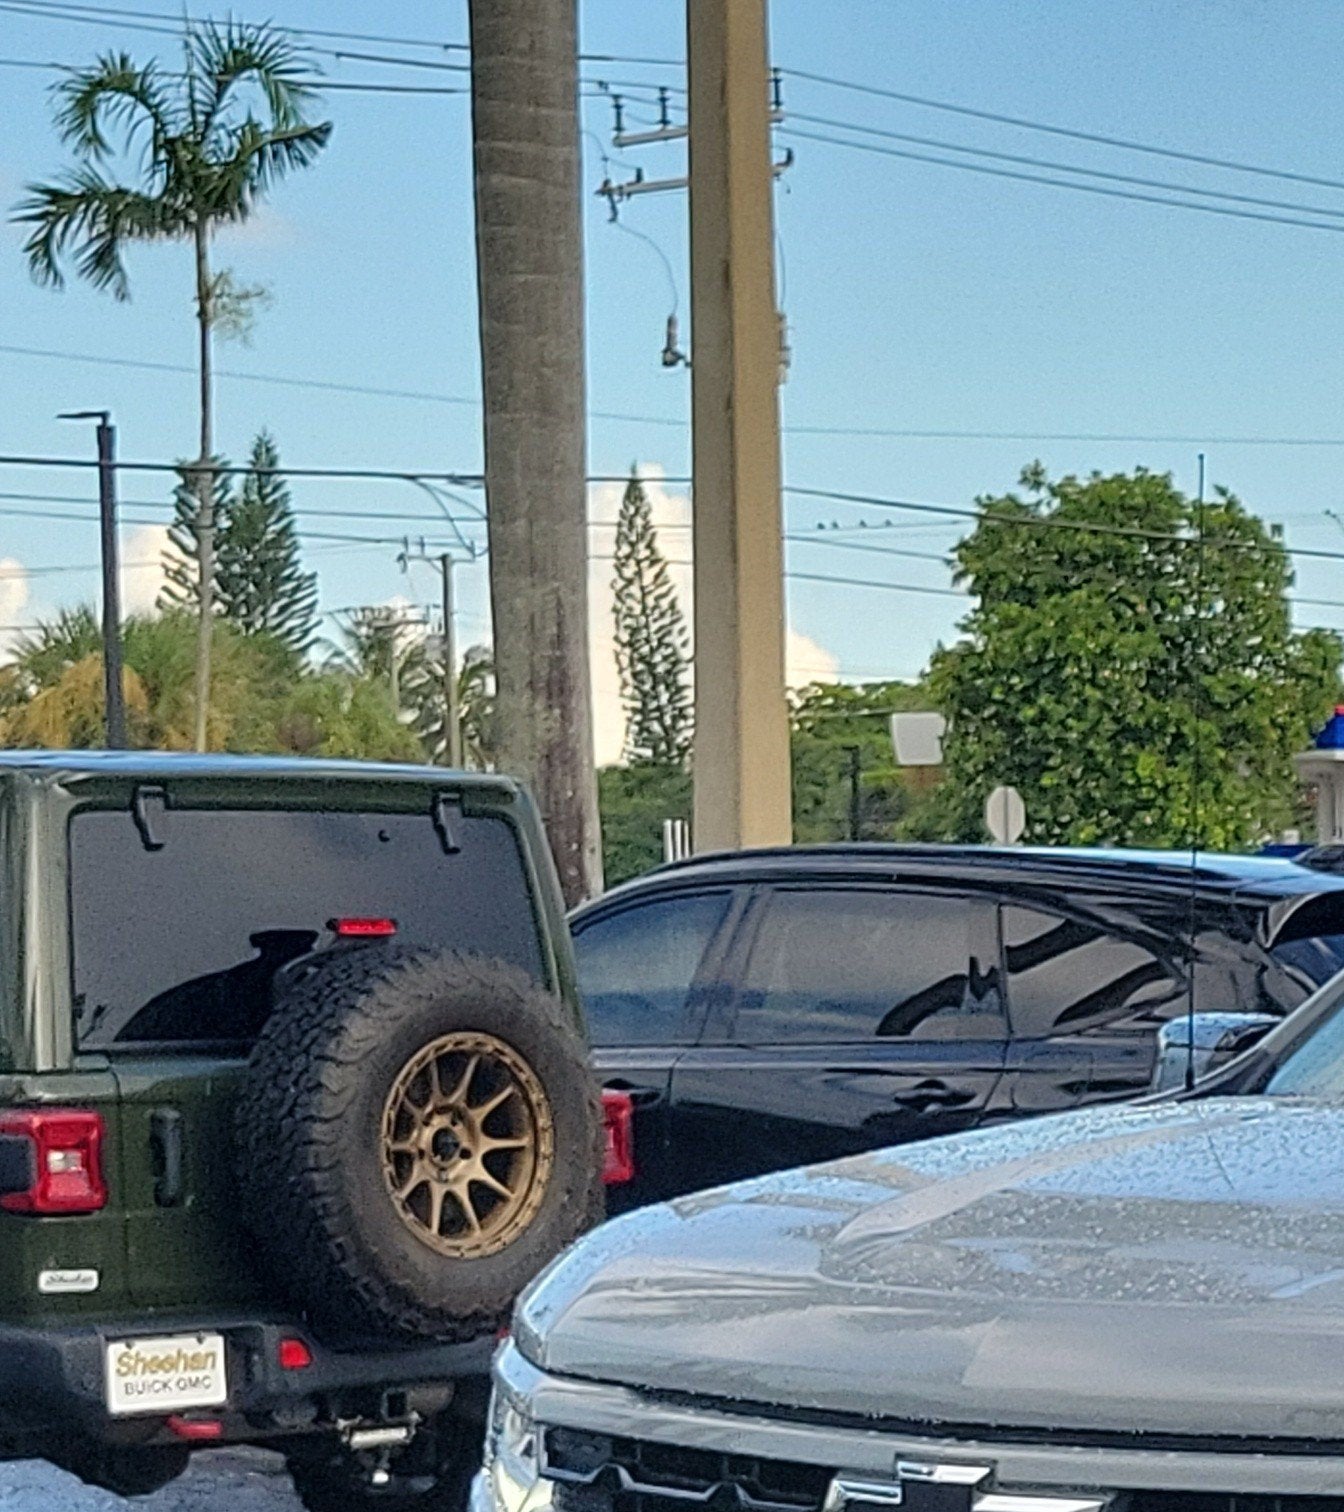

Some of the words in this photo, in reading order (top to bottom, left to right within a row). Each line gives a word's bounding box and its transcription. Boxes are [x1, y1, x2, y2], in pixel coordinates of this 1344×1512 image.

[116, 1348, 217, 1377] Sheehan
[124, 1378, 173, 1396] BUICK
[176, 1375, 212, 1390] GMC
